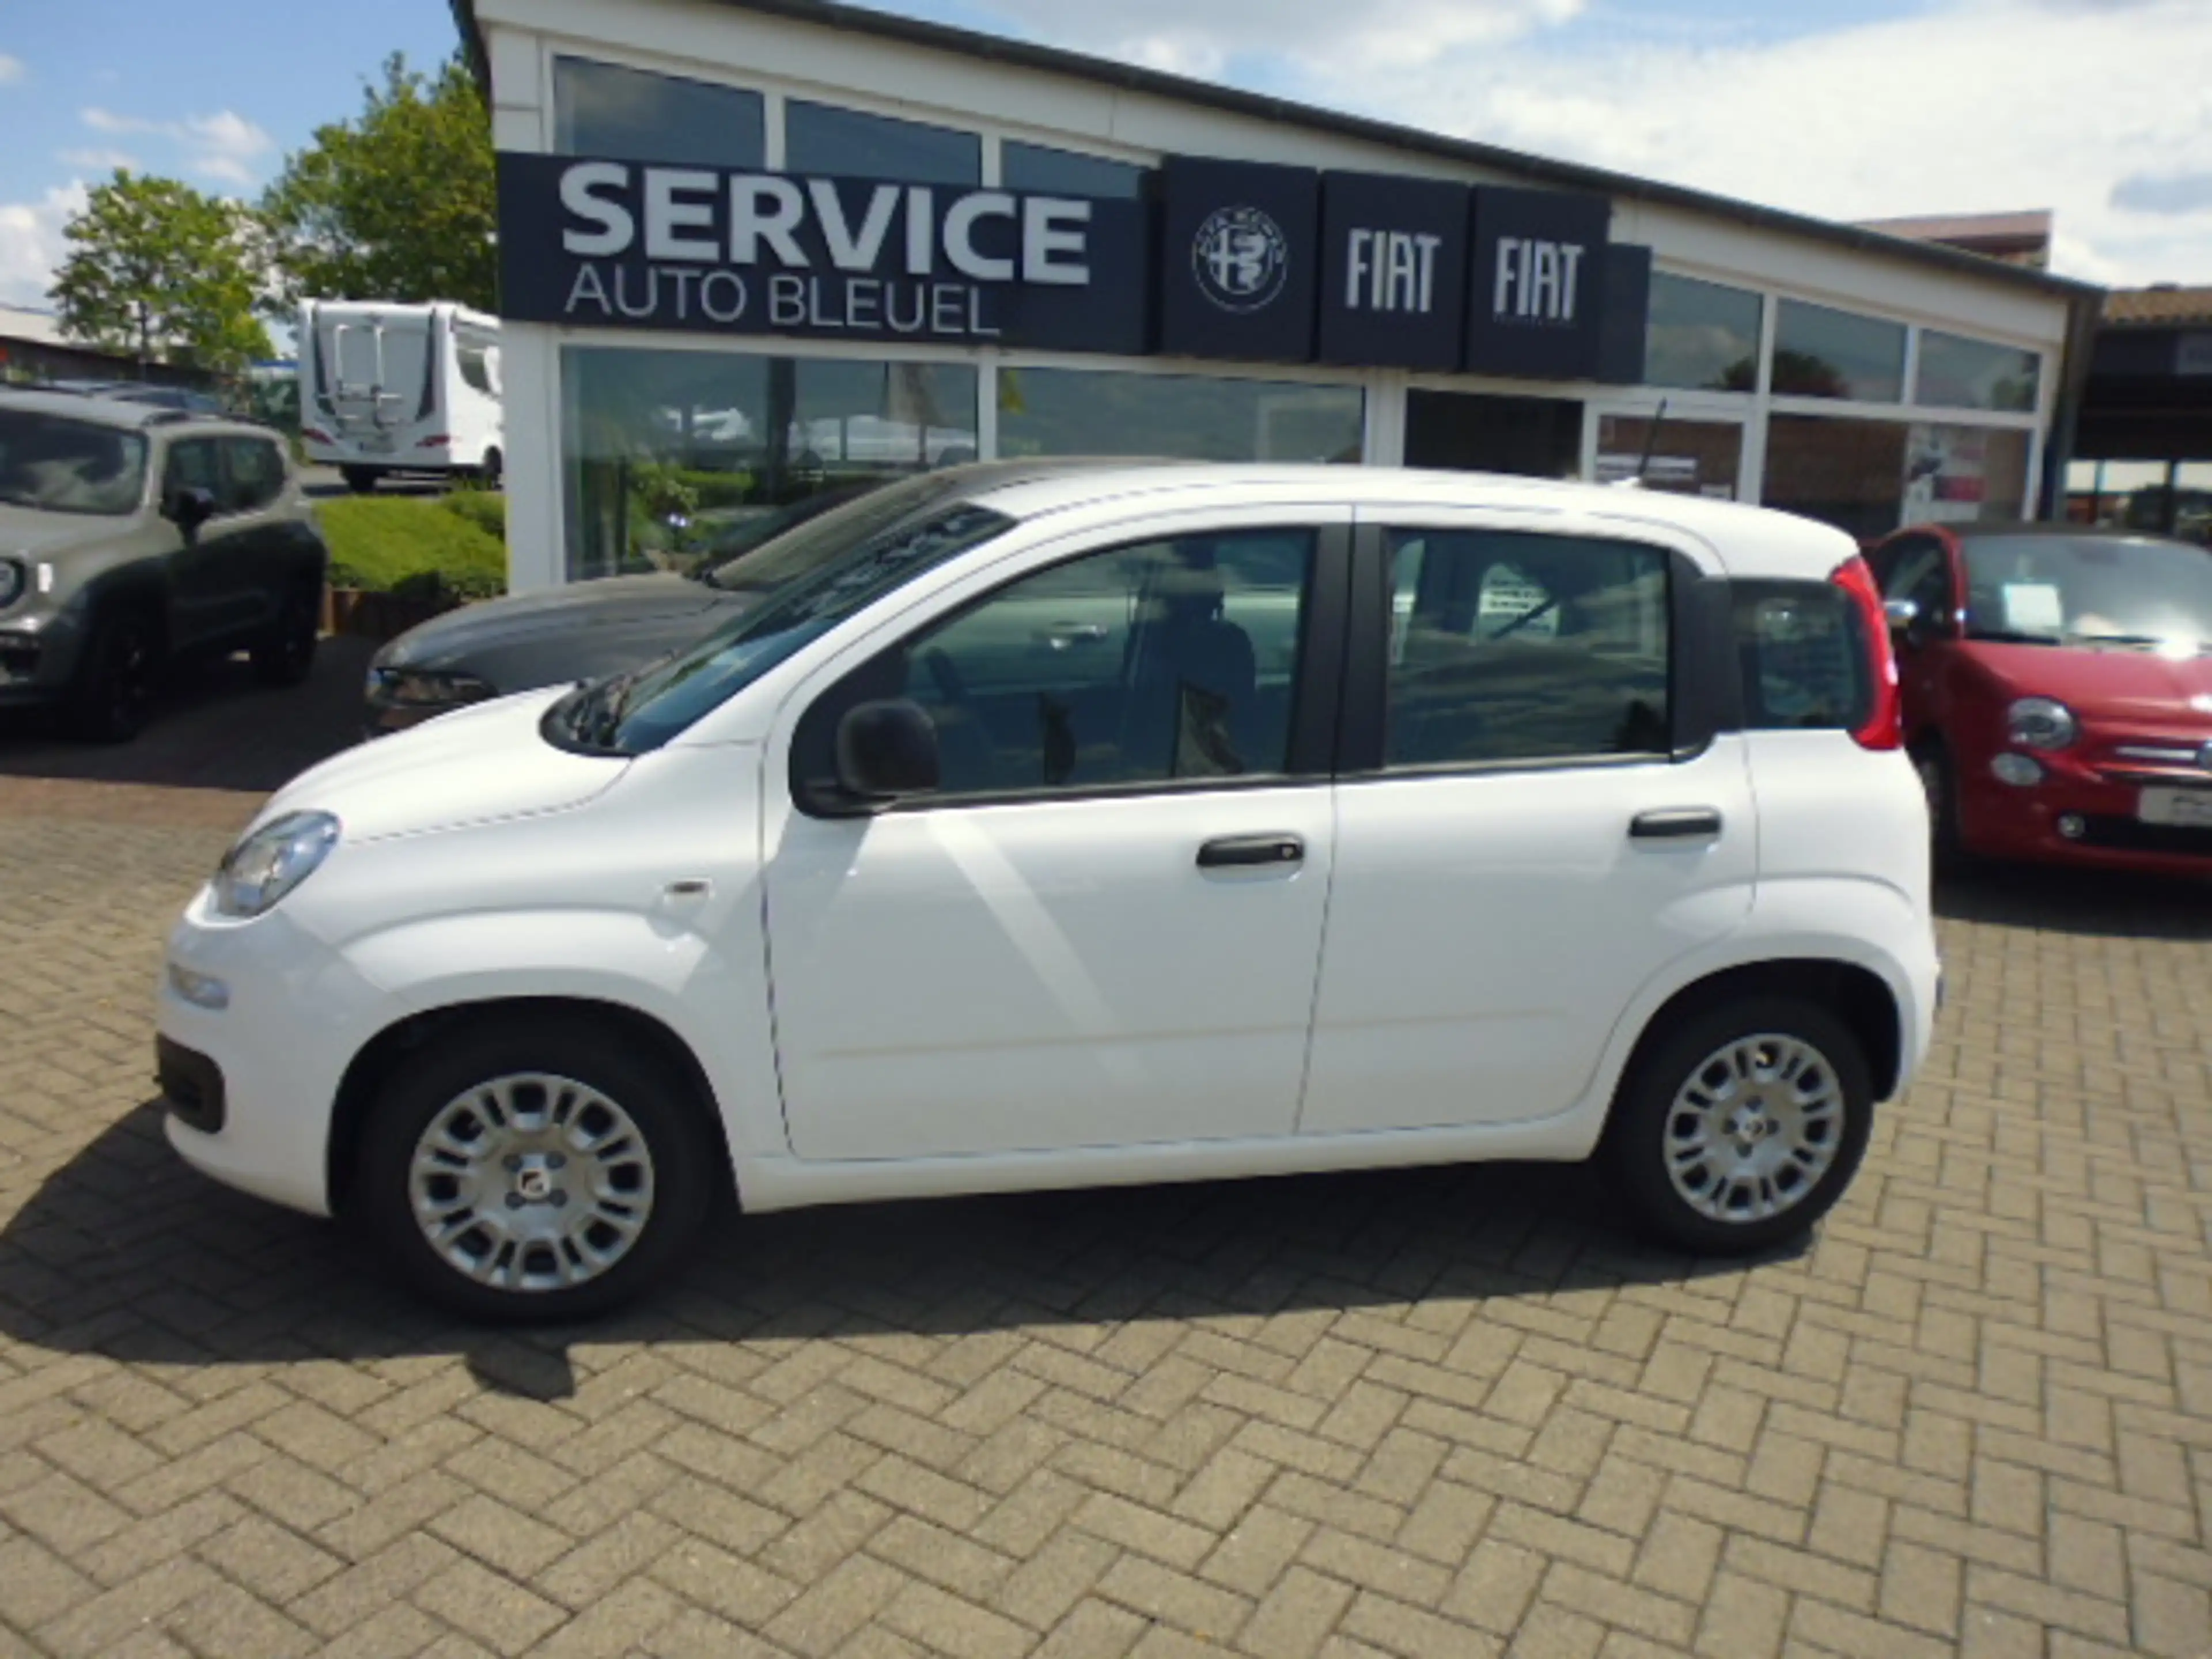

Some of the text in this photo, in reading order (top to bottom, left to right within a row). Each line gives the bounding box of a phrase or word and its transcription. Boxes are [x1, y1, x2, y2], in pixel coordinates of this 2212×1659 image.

[559, 161, 1091, 285] SERVICE
[565, 263, 1001, 336] AUTO BLEUEL
[1346, 228, 1442, 312] FIAT
[1493, 237, 1585, 320] FIAT
